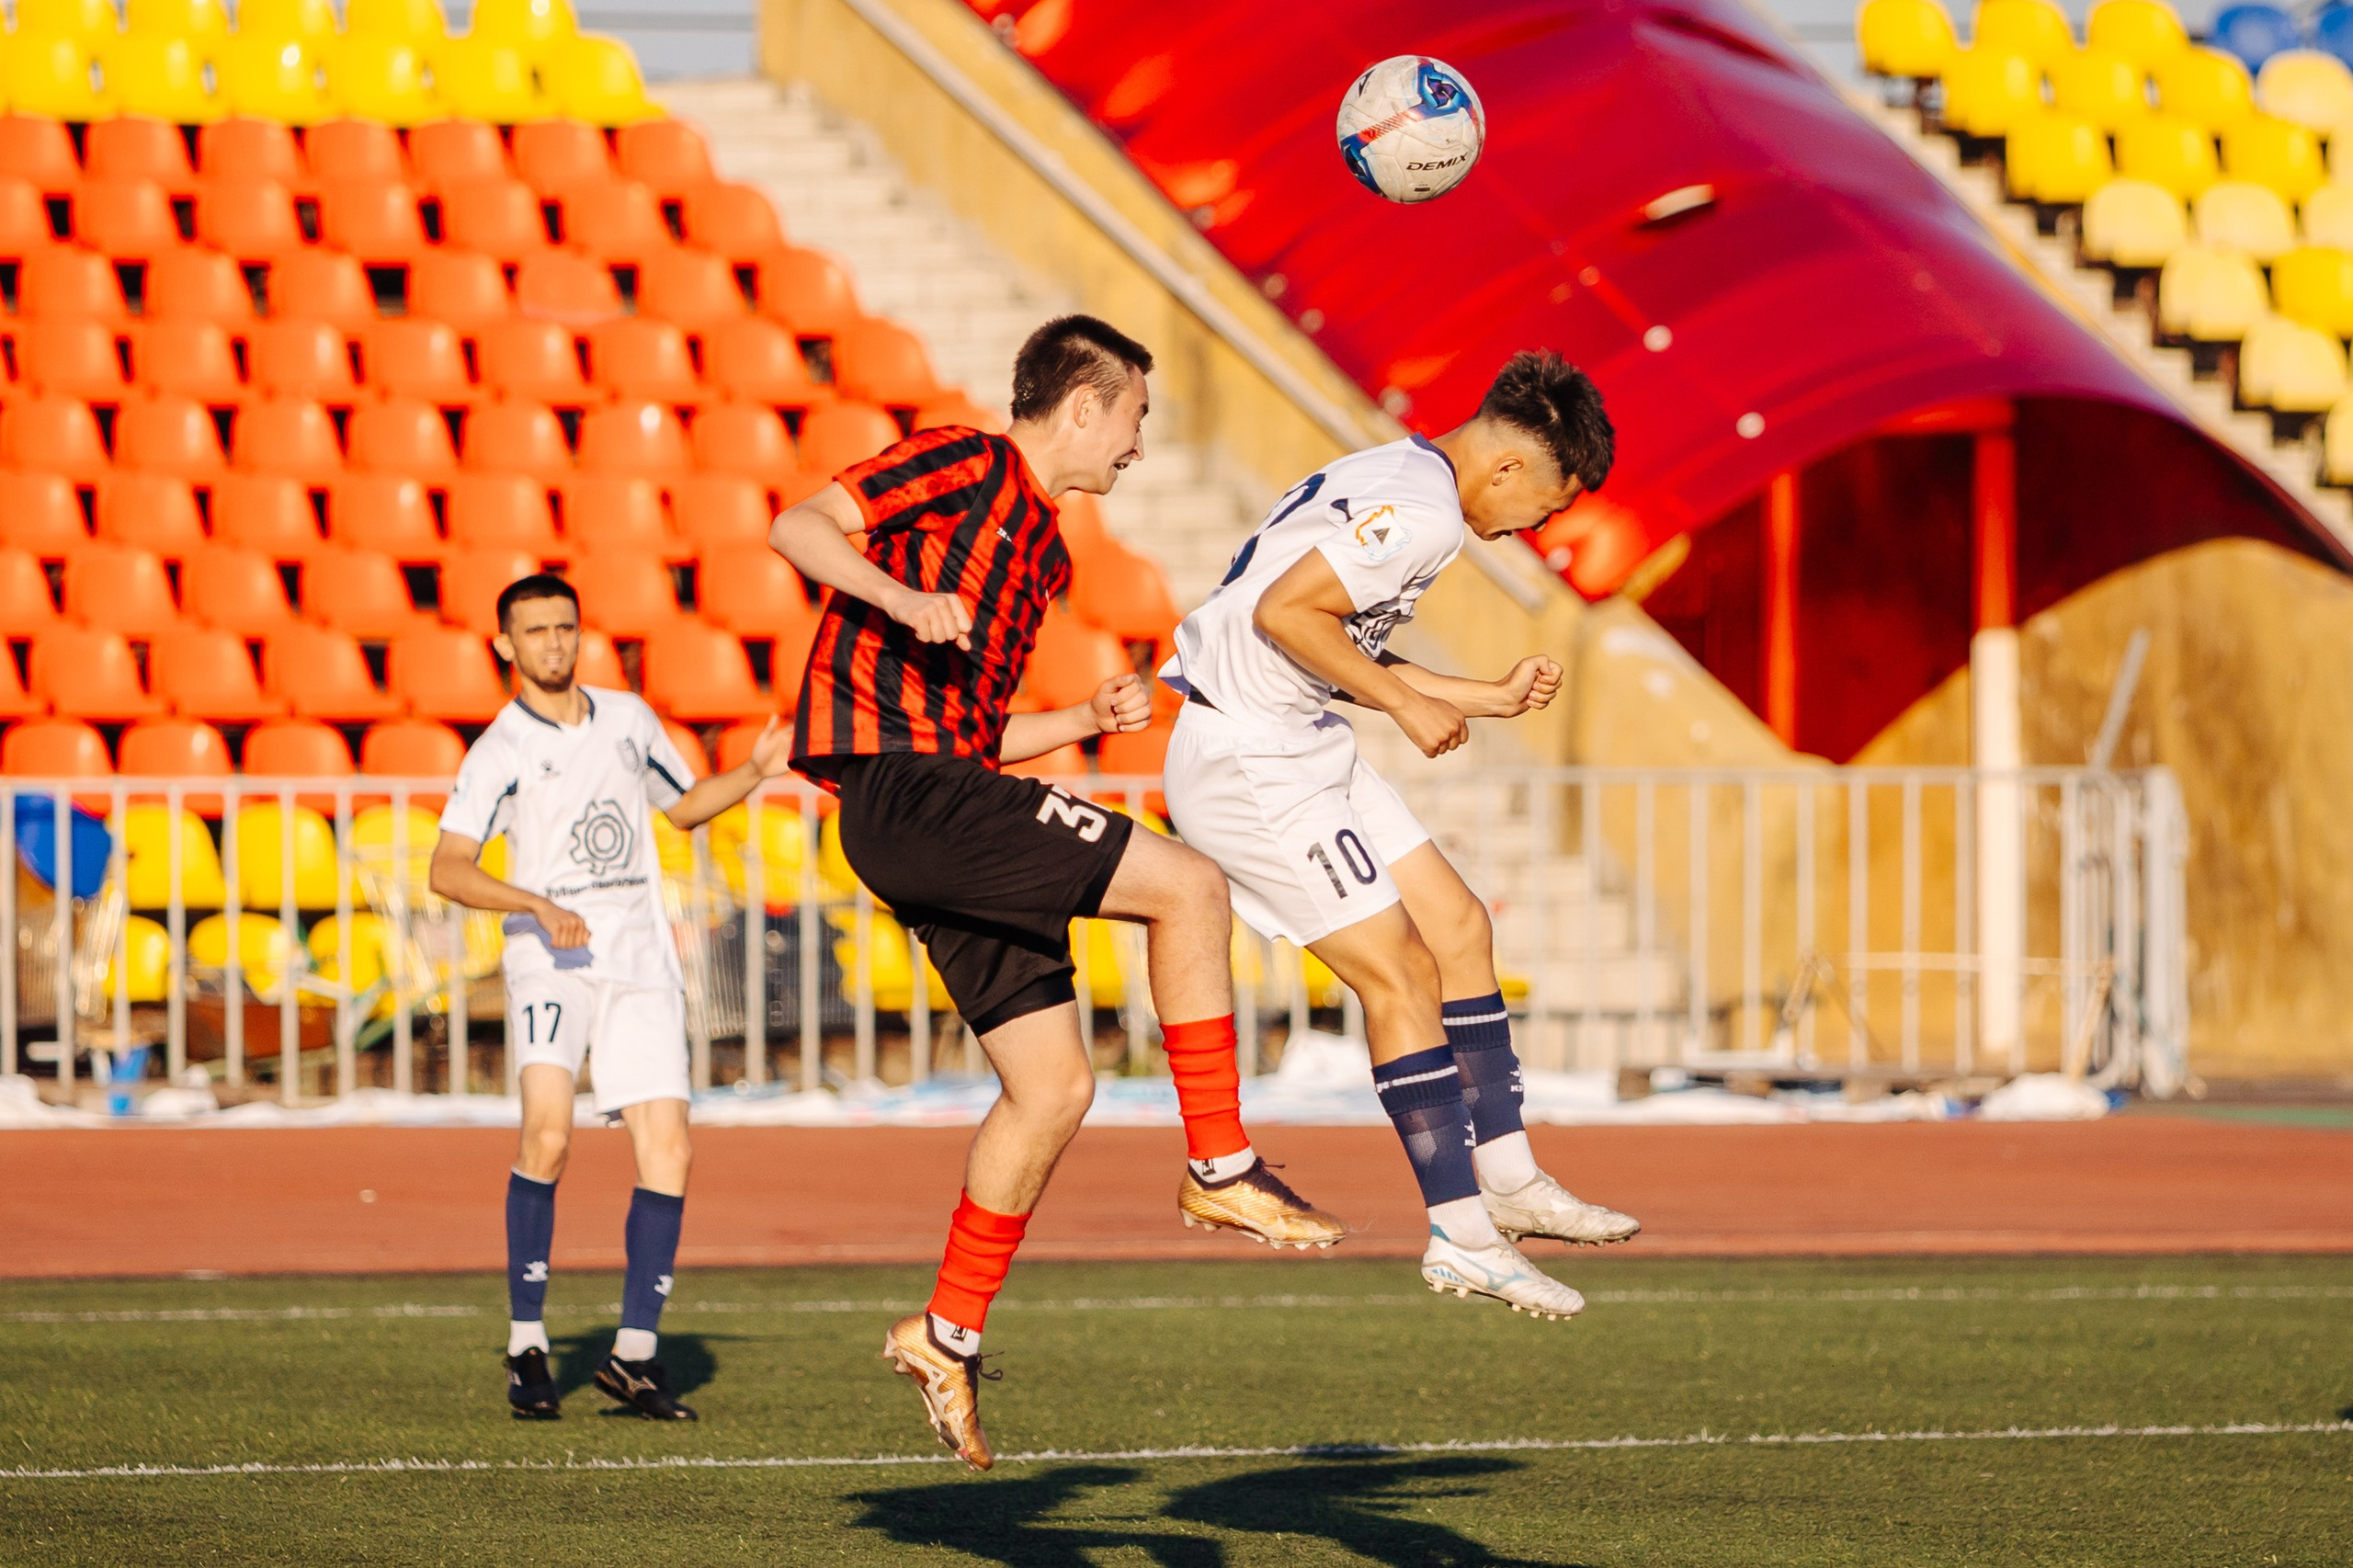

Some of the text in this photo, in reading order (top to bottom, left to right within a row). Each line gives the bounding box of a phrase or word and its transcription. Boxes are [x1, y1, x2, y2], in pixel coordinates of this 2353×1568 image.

[1406, 153, 1468, 170] DEMIX
[1036, 785, 1113, 843] 3
[1306, 828, 1377, 900] 10
[522, 1002, 562, 1044] 17
